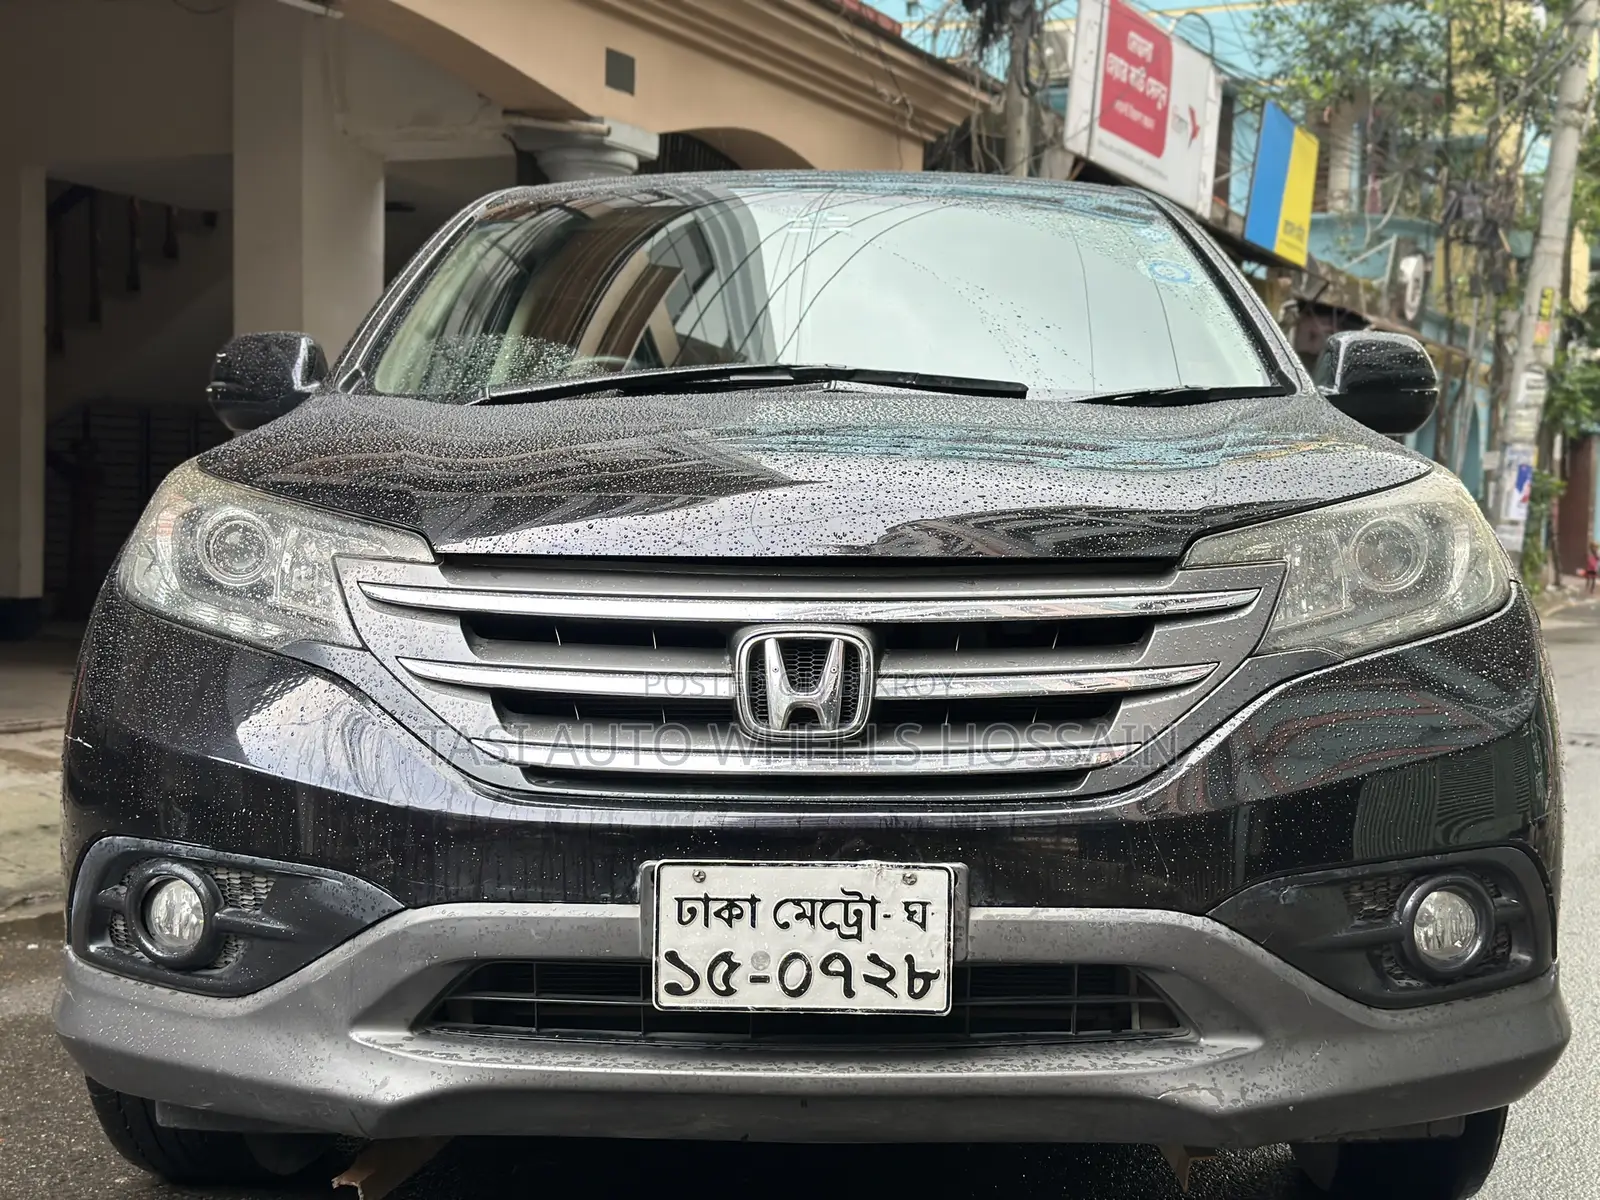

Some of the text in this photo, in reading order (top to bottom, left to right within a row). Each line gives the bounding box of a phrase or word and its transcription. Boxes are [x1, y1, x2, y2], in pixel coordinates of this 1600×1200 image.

[674, 892, 762, 929] ঢাকা
[902, 900, 932, 932] ঘ
[663, 950, 941, 1000] ১৫-০৭২৮
